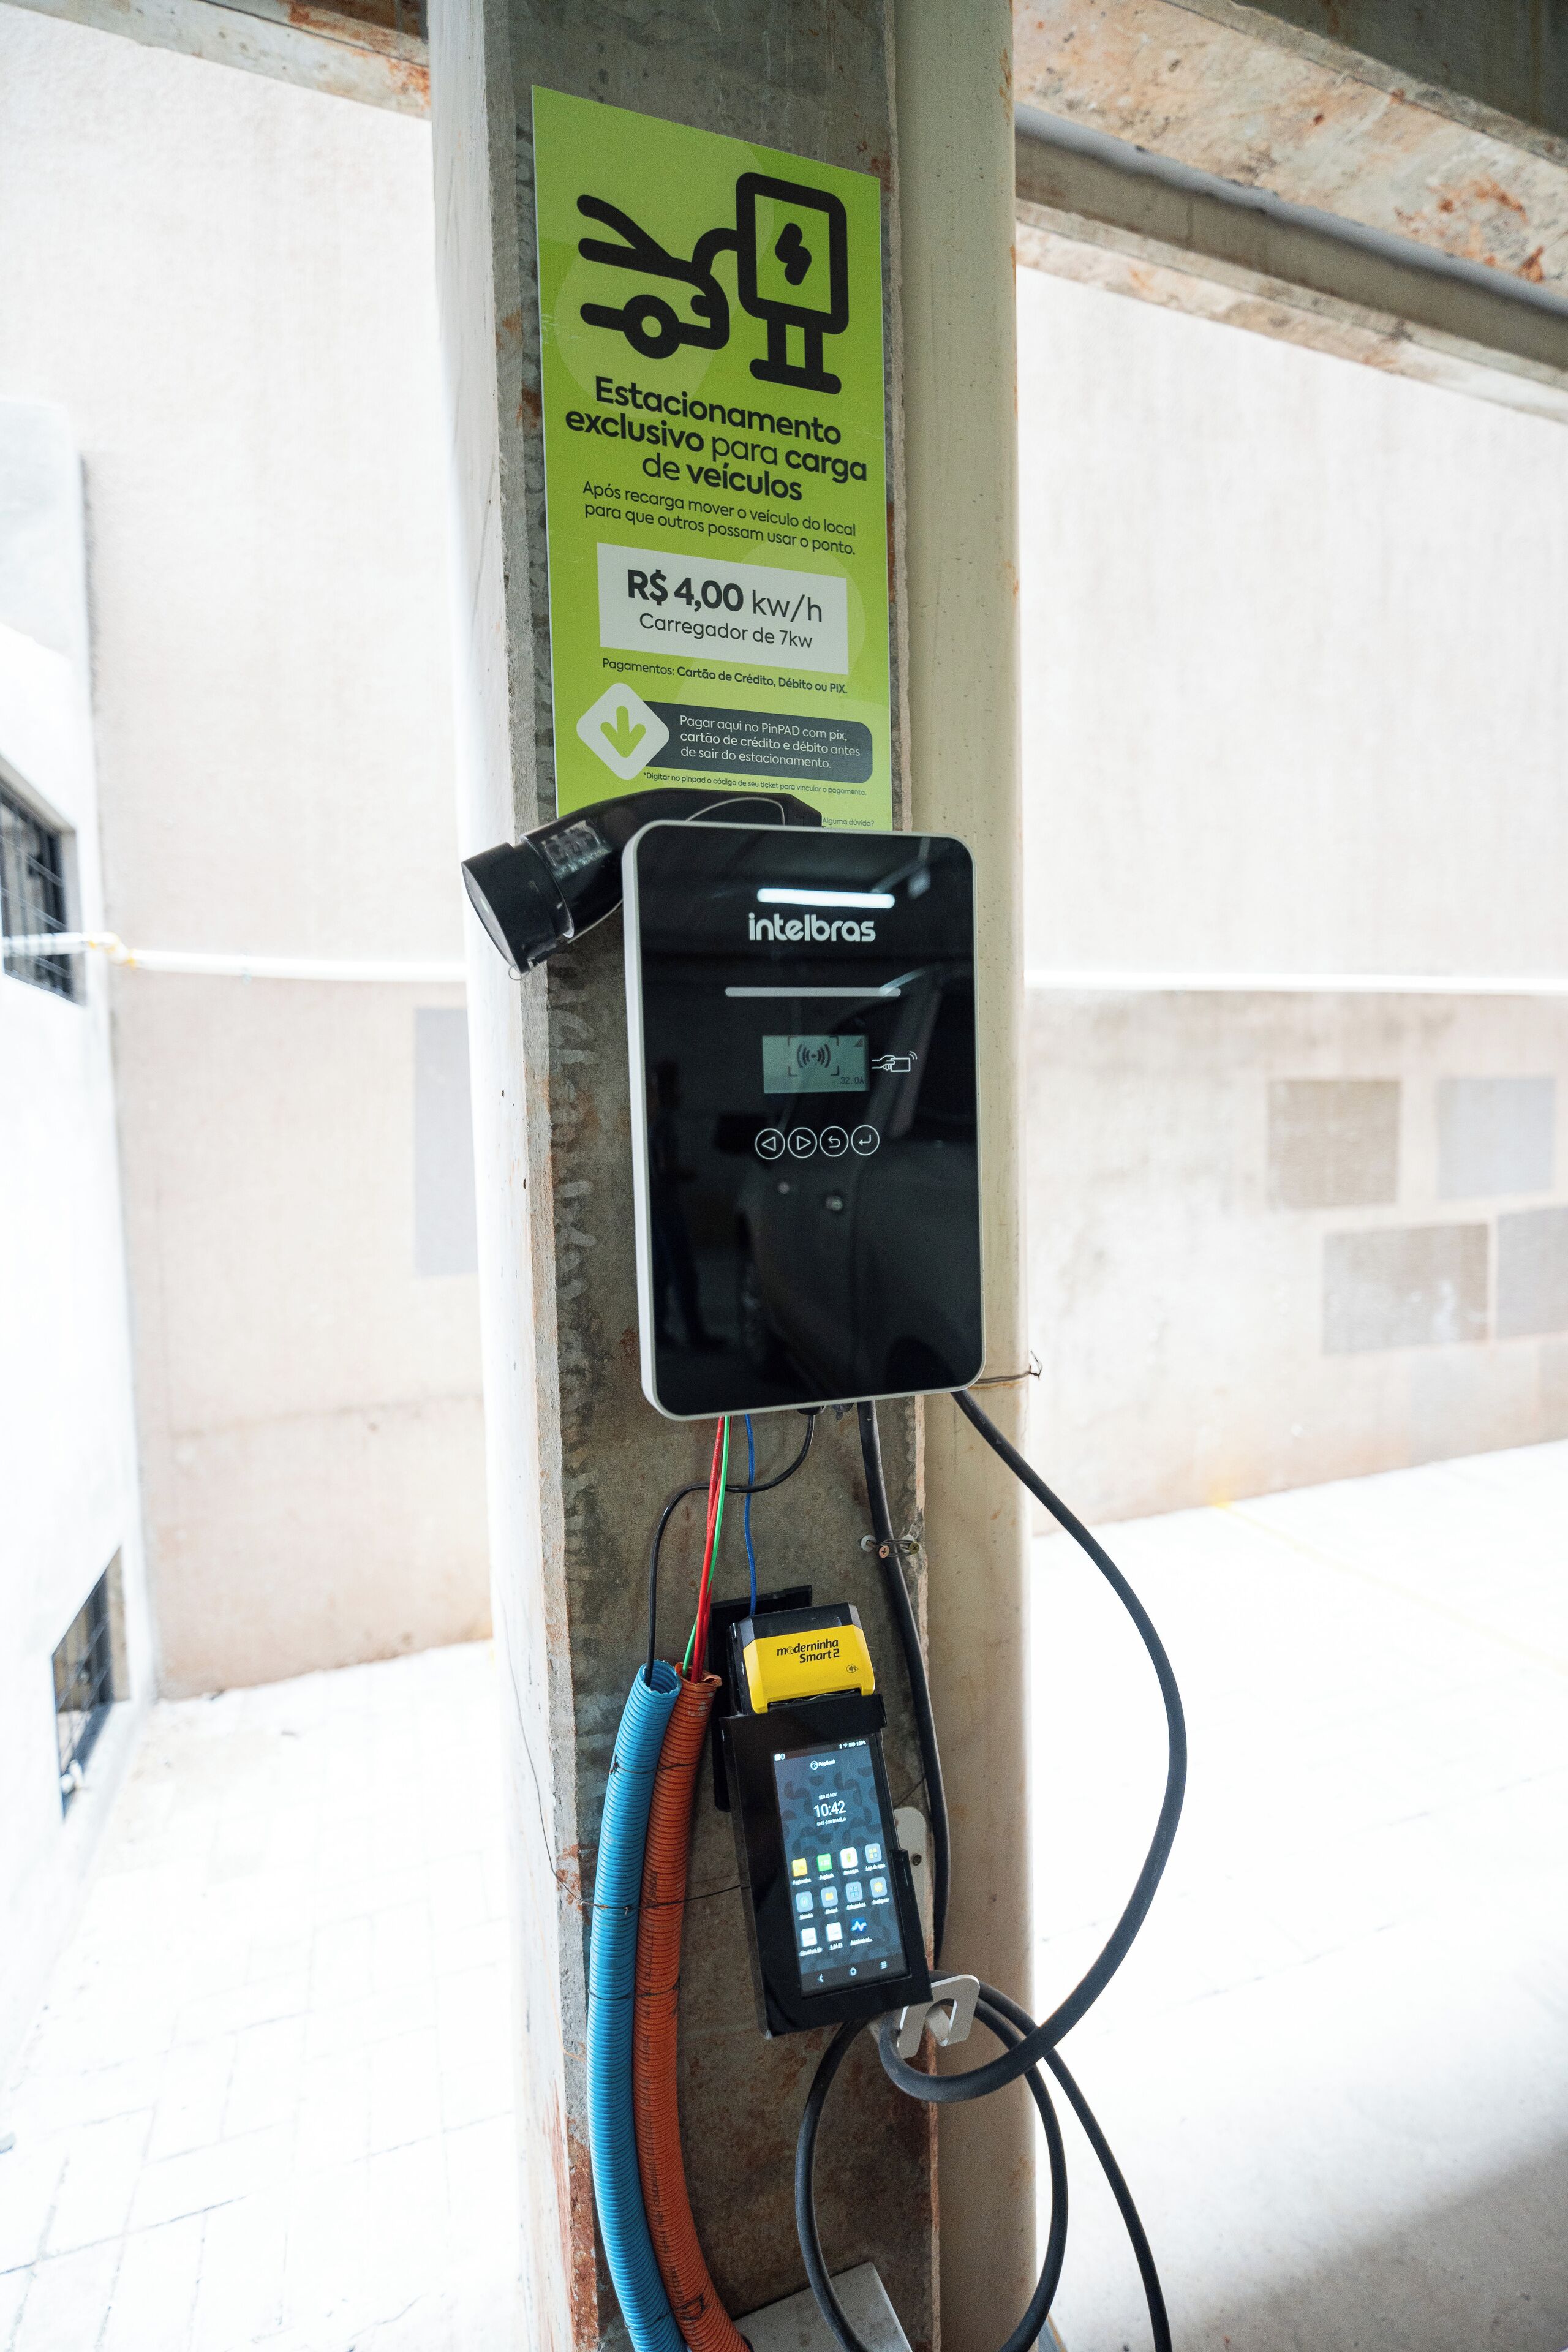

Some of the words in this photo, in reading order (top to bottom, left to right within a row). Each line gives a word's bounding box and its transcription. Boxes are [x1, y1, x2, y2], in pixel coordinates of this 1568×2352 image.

[596, 376, 841, 444] Estacionamento
[566, 411, 704, 451] exclusivo
[712, 437, 777, 465] para
[785, 450, 867, 483] carga
[643, 453, 680, 480] de
[687, 464, 802, 500] veículos
[583, 481, 620, 499] Após
[625, 491, 684, 511] recarga
[688, 501, 734, 516] mover
[737, 509, 746, 518] o
[750, 510, 799, 527] veículo
[802, 516, 820, 530] do
[824, 519, 855, 536] local
[586, 504, 621, 519] para
[625, 511, 654, 525] que
[658, 516, 704, 532] outros
[709, 524, 763, 541] possam
[767, 533, 797, 545] usar
[800, 538, 809, 548] o
[812, 540, 855, 555] ponto.
[628, 570, 668, 606] R$
[674, 578, 744, 612] 4,00
[753, 590, 821, 622] kw/h
[640, 613, 748, 640] Carregador
[753, 627, 774, 644] de
[780, 630, 812, 648] 7kw
[603, 658, 674, 675] Pagamentos:
[677, 666, 715, 679] Cartão
[718, 671, 732, 681] de
[734, 673, 775, 687] Crédito,
[779, 677, 812, 690] Débito
[830, 683, 847, 693] PIX.
[680, 715, 715, 729] Pagar
[717, 721, 741, 732] aqui
[762, 723, 799, 736] PinPAD
[829, 730, 846, 741] pix,
[680, 733, 720, 744] cartão
[723, 735, 737, 745] de
[741, 737, 780, 749] crédito
[793, 741, 828, 753] débito
[831, 746, 860, 756] antes
[681, 747, 696, 757] de
[699, 748, 718, 758] sair
[722, 750, 736, 760] do
[739, 753, 831, 768] estacionamento.
[712, 778, 737, 787] código
[748, 912, 876, 942] intelbras
[776, 1639, 839, 1656] moderninha
[799, 1649, 832, 1663] Smart
[833, 1648, 840, 1659] 2
[813, 1800, 846, 1818] 10:42
